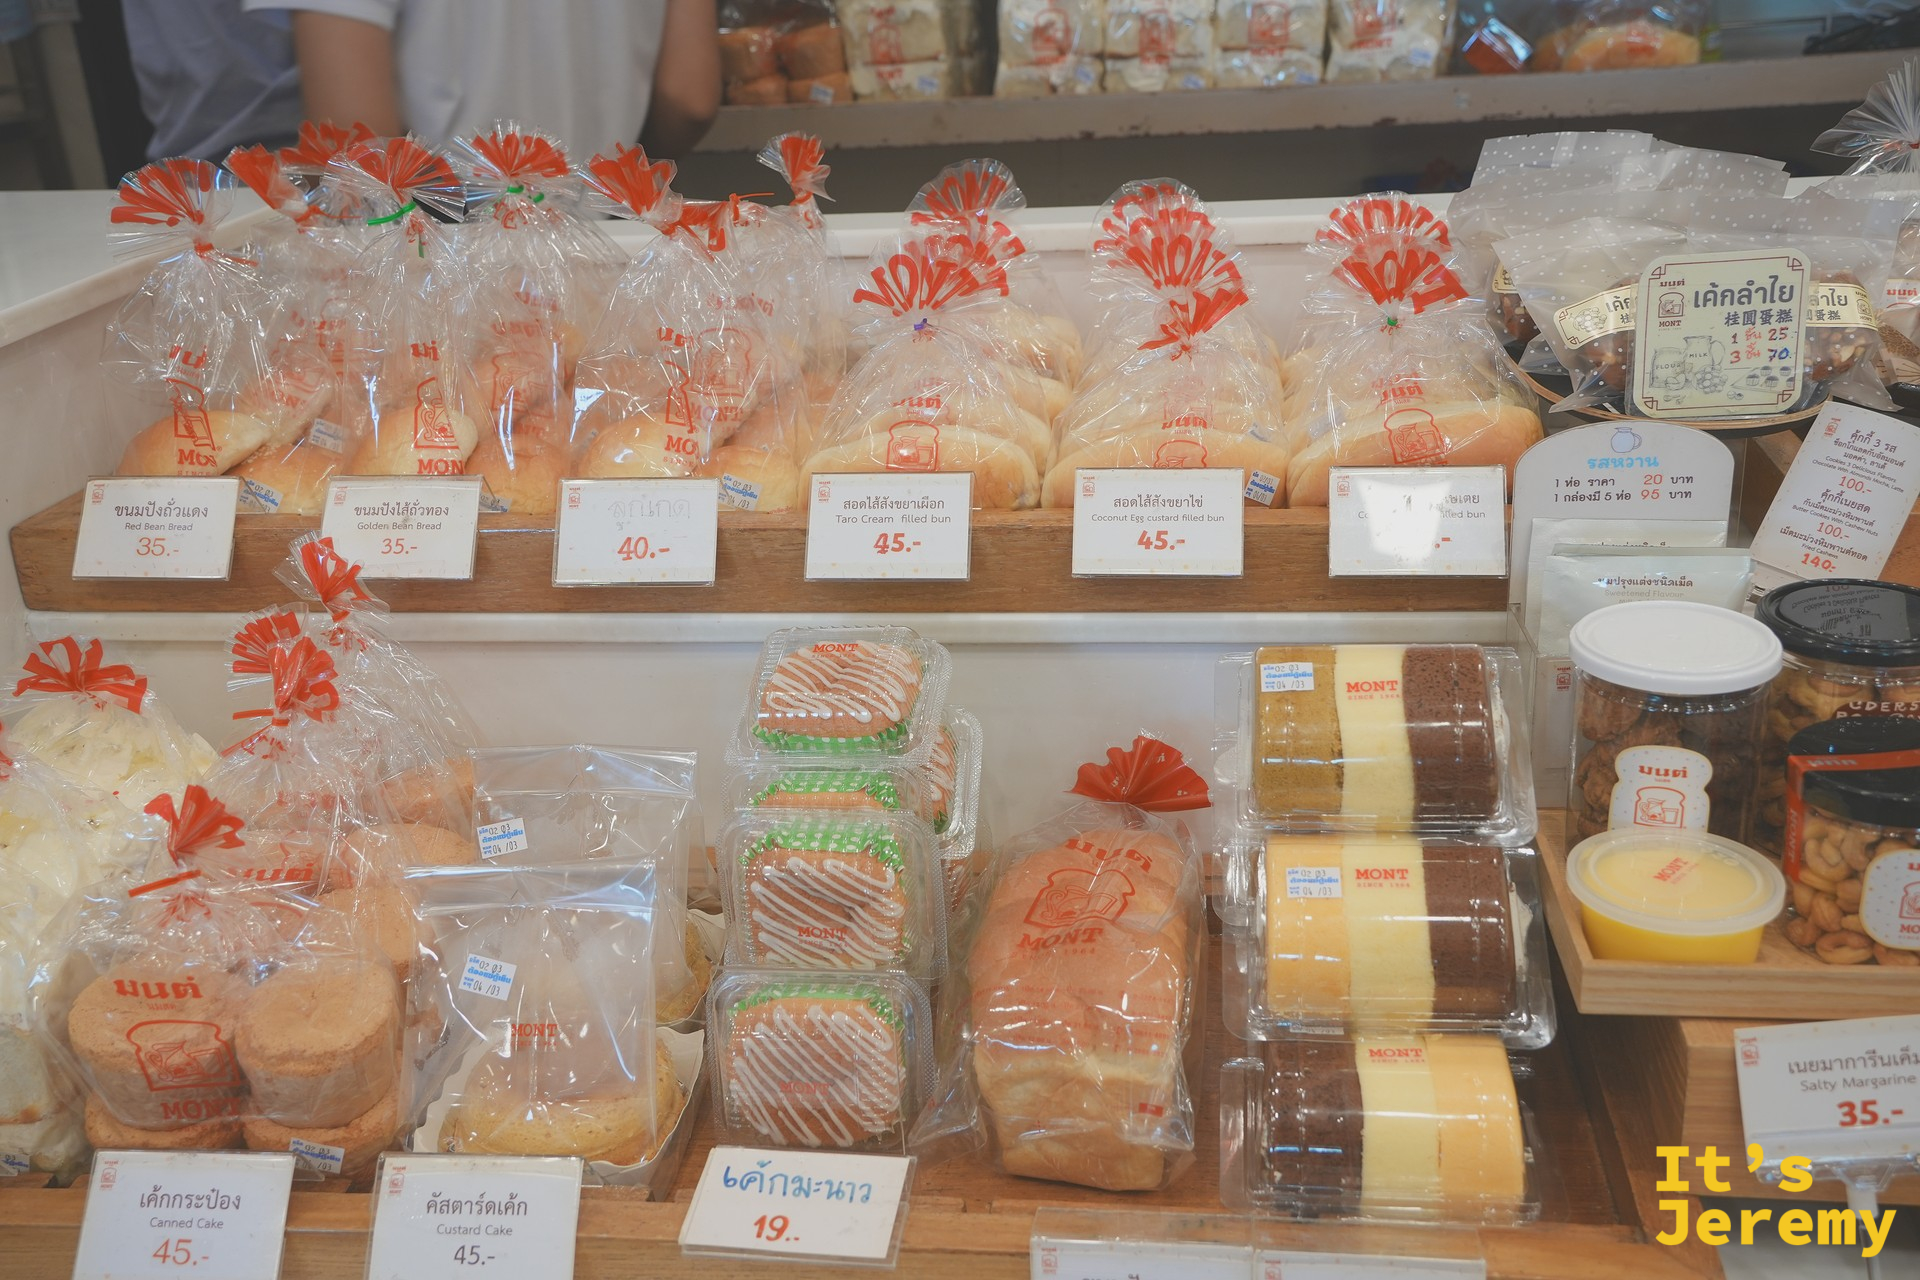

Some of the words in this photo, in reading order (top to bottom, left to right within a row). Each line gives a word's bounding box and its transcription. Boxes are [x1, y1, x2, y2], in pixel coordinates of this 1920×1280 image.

[1693, 275, 1795, 308] เค้กลำไย
[1658, 320, 1682, 328] MONT
[1724, 308, 1793, 327] 桂圓蛋糕
[1731, 333, 1738, 344] 1
[1730, 350, 1741, 364] 3
[1873, 439, 1882, 448] 3
[1884, 443, 1898, 454] รส
[418, 458, 465, 475] MON
[1587, 455, 1660, 470] รสหวาน
[1825, 455, 1846, 467] Cookies
[1852, 463, 1876, 476] Delicious
[1877, 472, 1897, 483] Flavors
[1555, 478, 1559, 488] 1
[1565, 476, 1581, 488] ห่อ
[1588, 478, 1615, 487] ราคา
[1643, 474, 1663, 485] 20
[1670, 475, 1694, 485] บาท
[1812, 459, 1837, 470] Chocolate
[1837, 465, 1849, 473] With
[1850, 470, 1872, 481] Almonds
[1872, 477, 1890, 488] Mocha,
[1891, 484, 1905, 493] Latte
[1839, 476, 1872, 494] 100.-
[843, 495, 945, 510] สอดไส้สังขยาเผือก
[1113, 494, 1204, 508] สอดไส้สังขยาไข่
[1554, 493, 1559, 502] 1
[1564, 490, 1601, 502] กล่องมี
[1604, 493, 1612, 501] 5
[1616, 489, 1632, 501] ห่อ
[1641, 489, 1660, 500] 95
[1669, 489, 1692, 499] บาท
[114, 498, 209, 518] ขนมปังถั่วแดง
[354, 499, 450, 517] ขนมปังไส้ถั่วทอง
[1466, 511, 1486, 519] bun
[357, 521, 389, 530] Golden
[392, 521, 414, 530] Bean
[416, 521, 442, 530] Bread
[836, 514, 858, 524] Taro
[861, 514, 894, 524] Cream
[901, 514, 927, 524] filled
[931, 514, 952, 524] bun
[1091, 514, 1128, 522] Coconut
[1130, 514, 1145, 524] Egg
[1147, 514, 1179, 522] custard
[1182, 513, 1205, 522] filled
[1207, 514, 1225, 522] bun
[1792, 504, 1809, 514] Butter
[1809, 510, 1830, 520] Cookies
[1831, 516, 1844, 524] With
[1844, 521, 1865, 532] Cashew
[1865, 528, 1879, 537] Nuts
[125, 522, 141, 531] Red
[144, 522, 165, 531] Bean
[168, 522, 194, 531] Bread
[1817, 522, 1850, 540] 100.-
[136, 537, 180, 557] 35.-
[381, 538, 418, 555] 35.-
[873, 532, 921, 555] 45.-
[1137, 530, 1185, 551] 45.-
[617, 536, 671, 561] 40.-
[1801, 543, 1816, 552] Fried
[1816, 548, 1839, 560] Cashews
[1604, 589, 1651, 598] Sweetened
[1653, 590, 1685, 598] Flavour
[812, 643, 859, 653] MONT
[1276, 681, 1286, 689] 04
[1346, 680, 1398, 693] MONT
[1638, 765, 1689, 778] มนต์
[489, 827, 499, 836] 02
[1300, 869, 1311, 877] 02
[1355, 868, 1409, 880] MONT
[1652, 857, 1689, 883] MONT
[1303, 886, 1313, 896] 04
[797, 926, 848, 941] MONT
[1016, 927, 1103, 950] MONT
[479, 960, 490, 971] 02
[113, 976, 204, 1000] มนต์
[511, 1023, 558, 1038] MONT
[1368, 1048, 1423, 1058] MONT
[1800, 1078, 1838, 1092] Salty
[1842, 1073, 1917, 1089] Margarine
[160, 1097, 242, 1120] MONT
[1837, 1099, 1904, 1128] 35.-
[723, 1160, 873, 1204] เค้กมะนาว
[139, 1184, 241, 1210] เค้กกระป๋อง
[426, 1191, 528, 1216] คัสตาร์ดเค้ก
[149, 1217, 193, 1229] Canned
[197, 1218, 224, 1229] Cake
[436, 1223, 481, 1236] Custard
[485, 1225, 513, 1236] Cake
[152, 1238, 210, 1266] 45.-
[454, 1244, 496, 1266] 45.-
